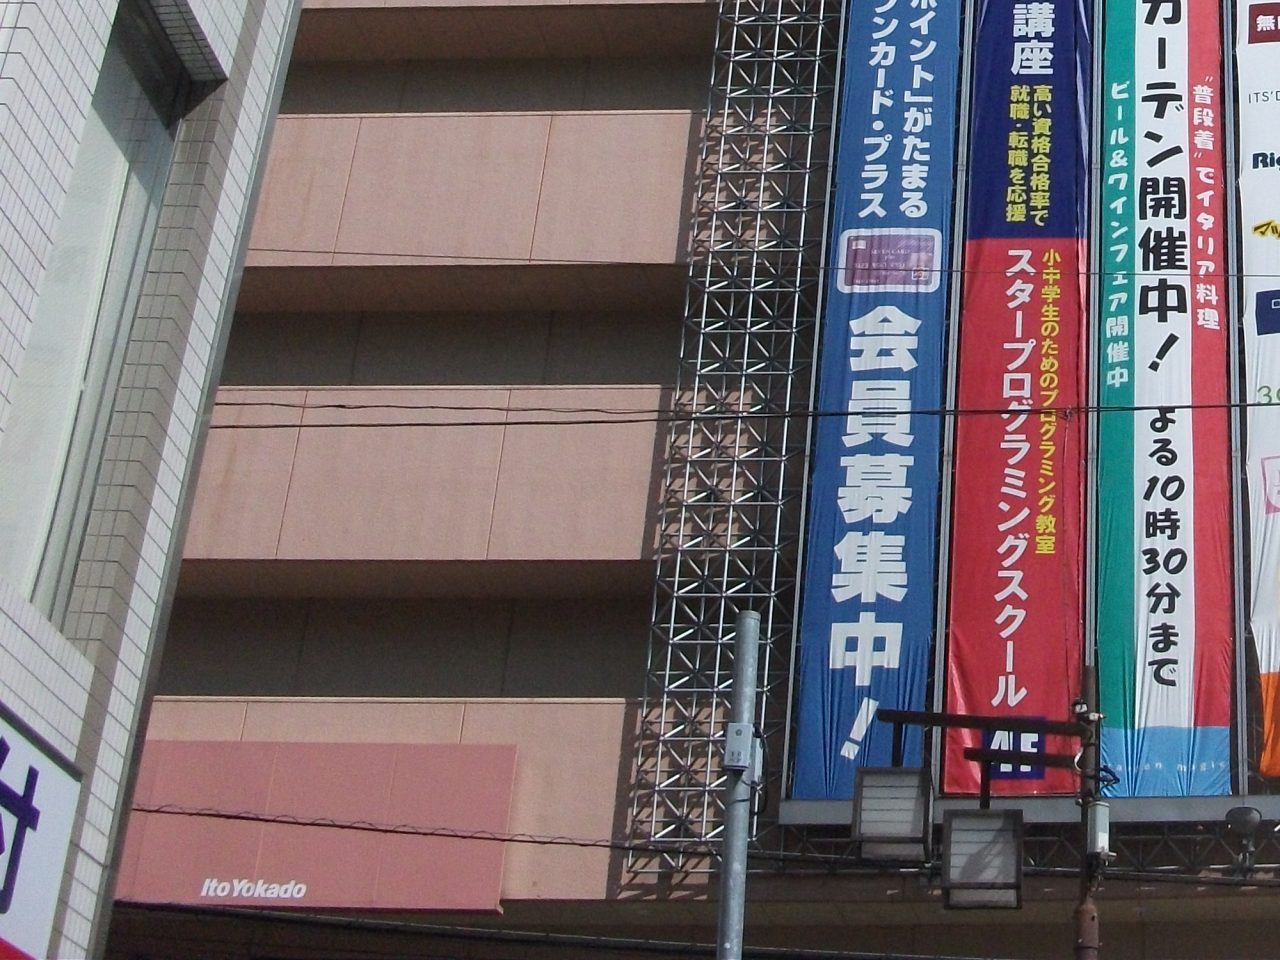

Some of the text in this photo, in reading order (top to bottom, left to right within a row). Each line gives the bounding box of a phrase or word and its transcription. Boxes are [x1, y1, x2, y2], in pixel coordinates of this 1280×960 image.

[1029, 85, 1053, 227] 高い資格合格率で
[991, 248, 1036, 708] スタープログラミングスクール
